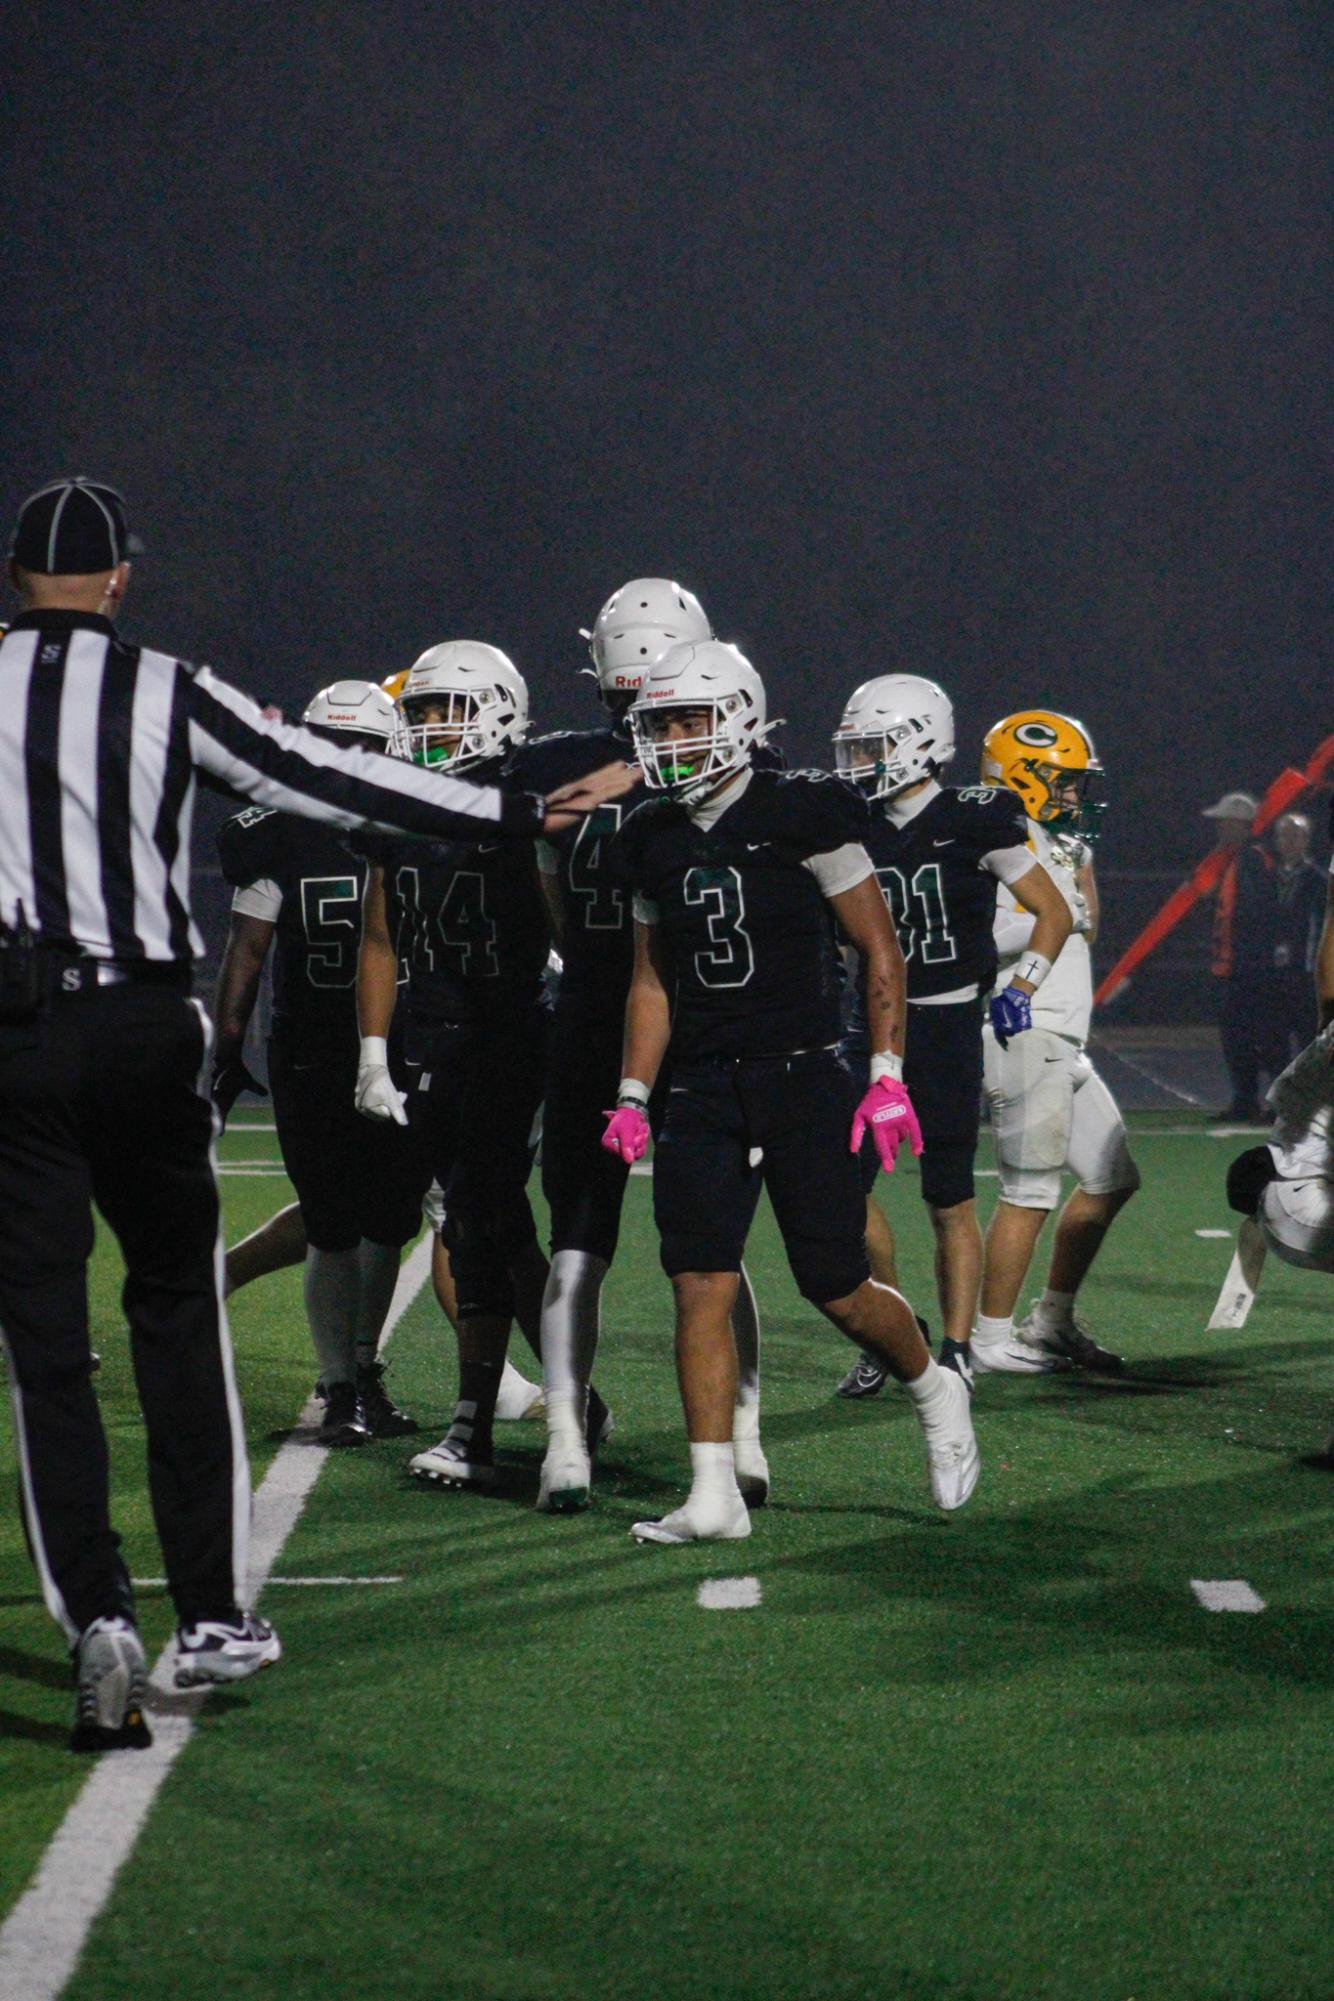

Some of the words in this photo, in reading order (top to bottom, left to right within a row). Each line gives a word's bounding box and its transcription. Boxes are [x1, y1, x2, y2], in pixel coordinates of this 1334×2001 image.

[1014, 722, 1058, 748] C
[396, 866, 500, 979] 14
[684, 865, 755, 988] 3
[61, 967, 82, 992] S
